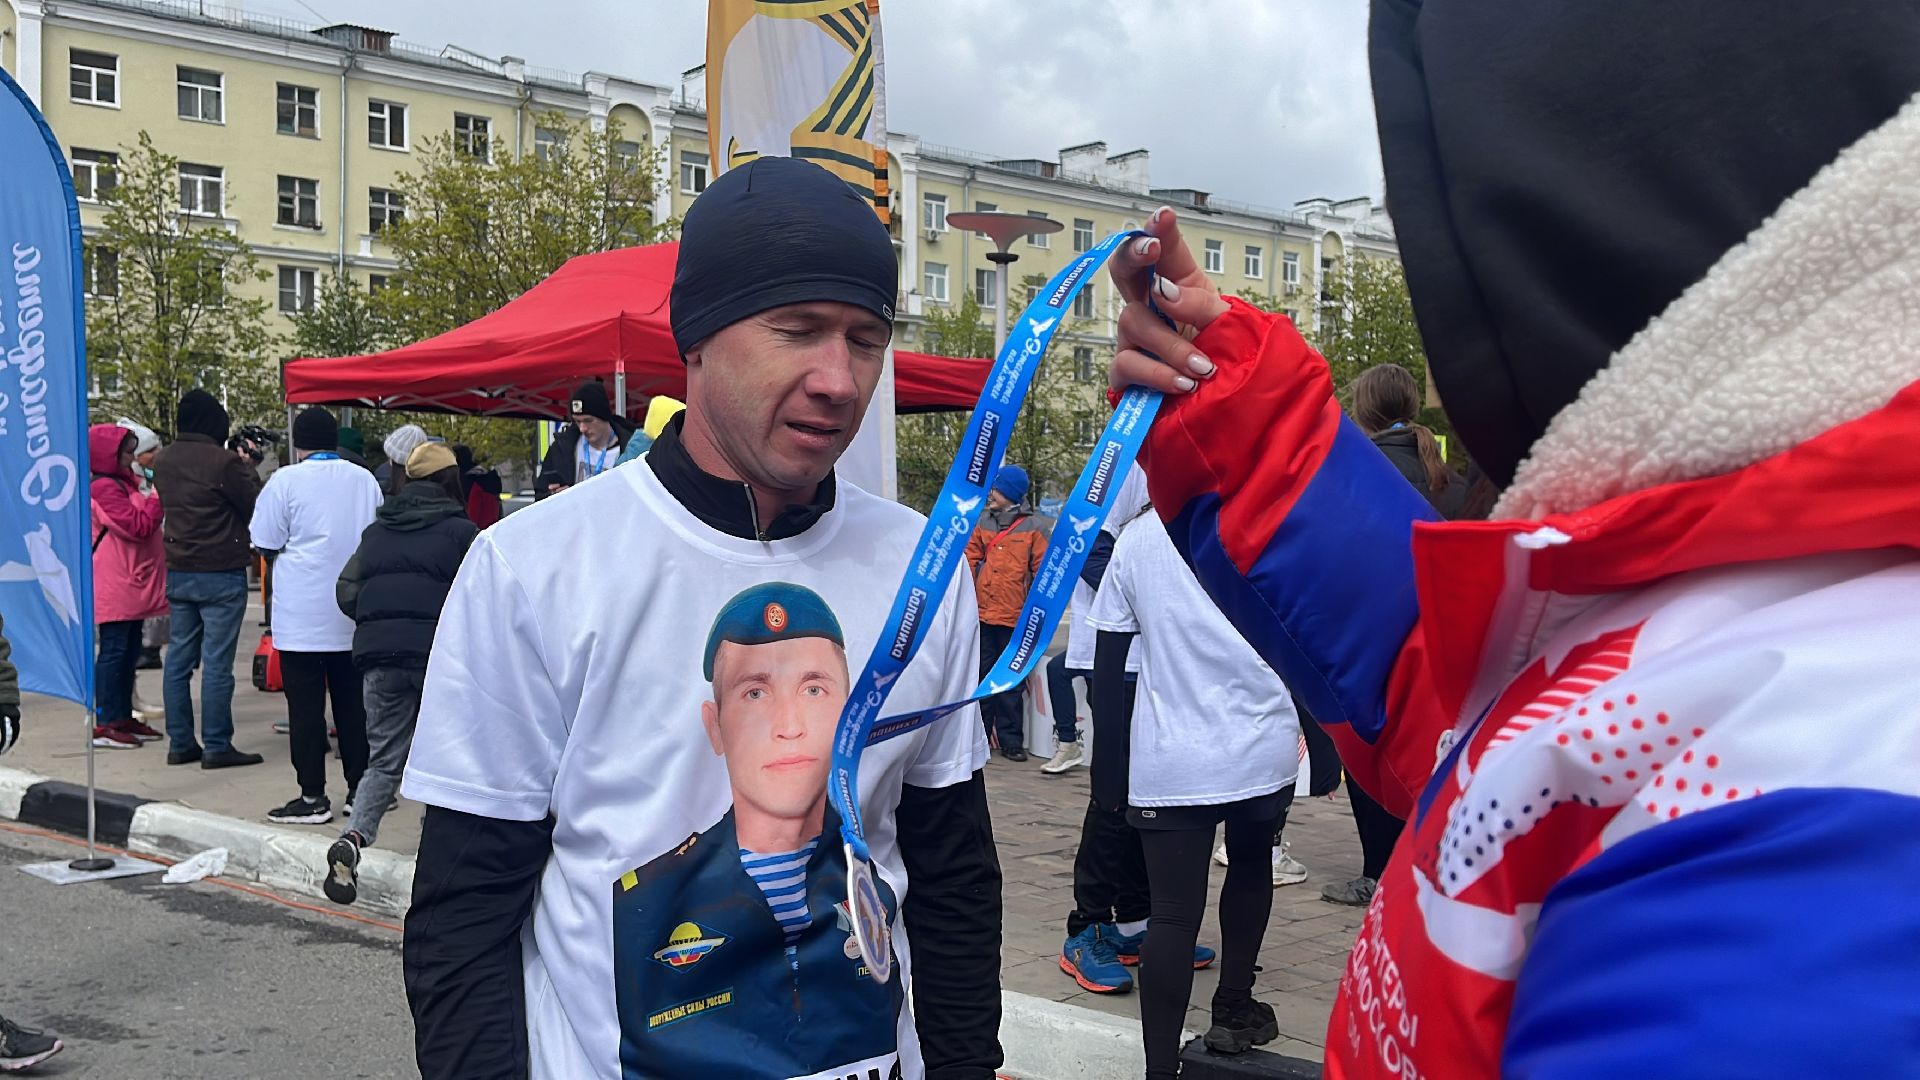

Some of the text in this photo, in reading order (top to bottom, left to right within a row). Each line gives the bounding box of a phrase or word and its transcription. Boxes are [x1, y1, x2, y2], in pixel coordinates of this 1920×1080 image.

[1049, 257, 1095, 306] Балашиха
[1002, 337, 1042, 406] Эстафета
[1122, 389, 1151, 436] стафета
[967, 411, 999, 483] Балашиха
[1087, 440, 1121, 503] Балашиха
[892, 588, 927, 659] Балашиха
[1011, 606, 1046, 671] Балашиха
